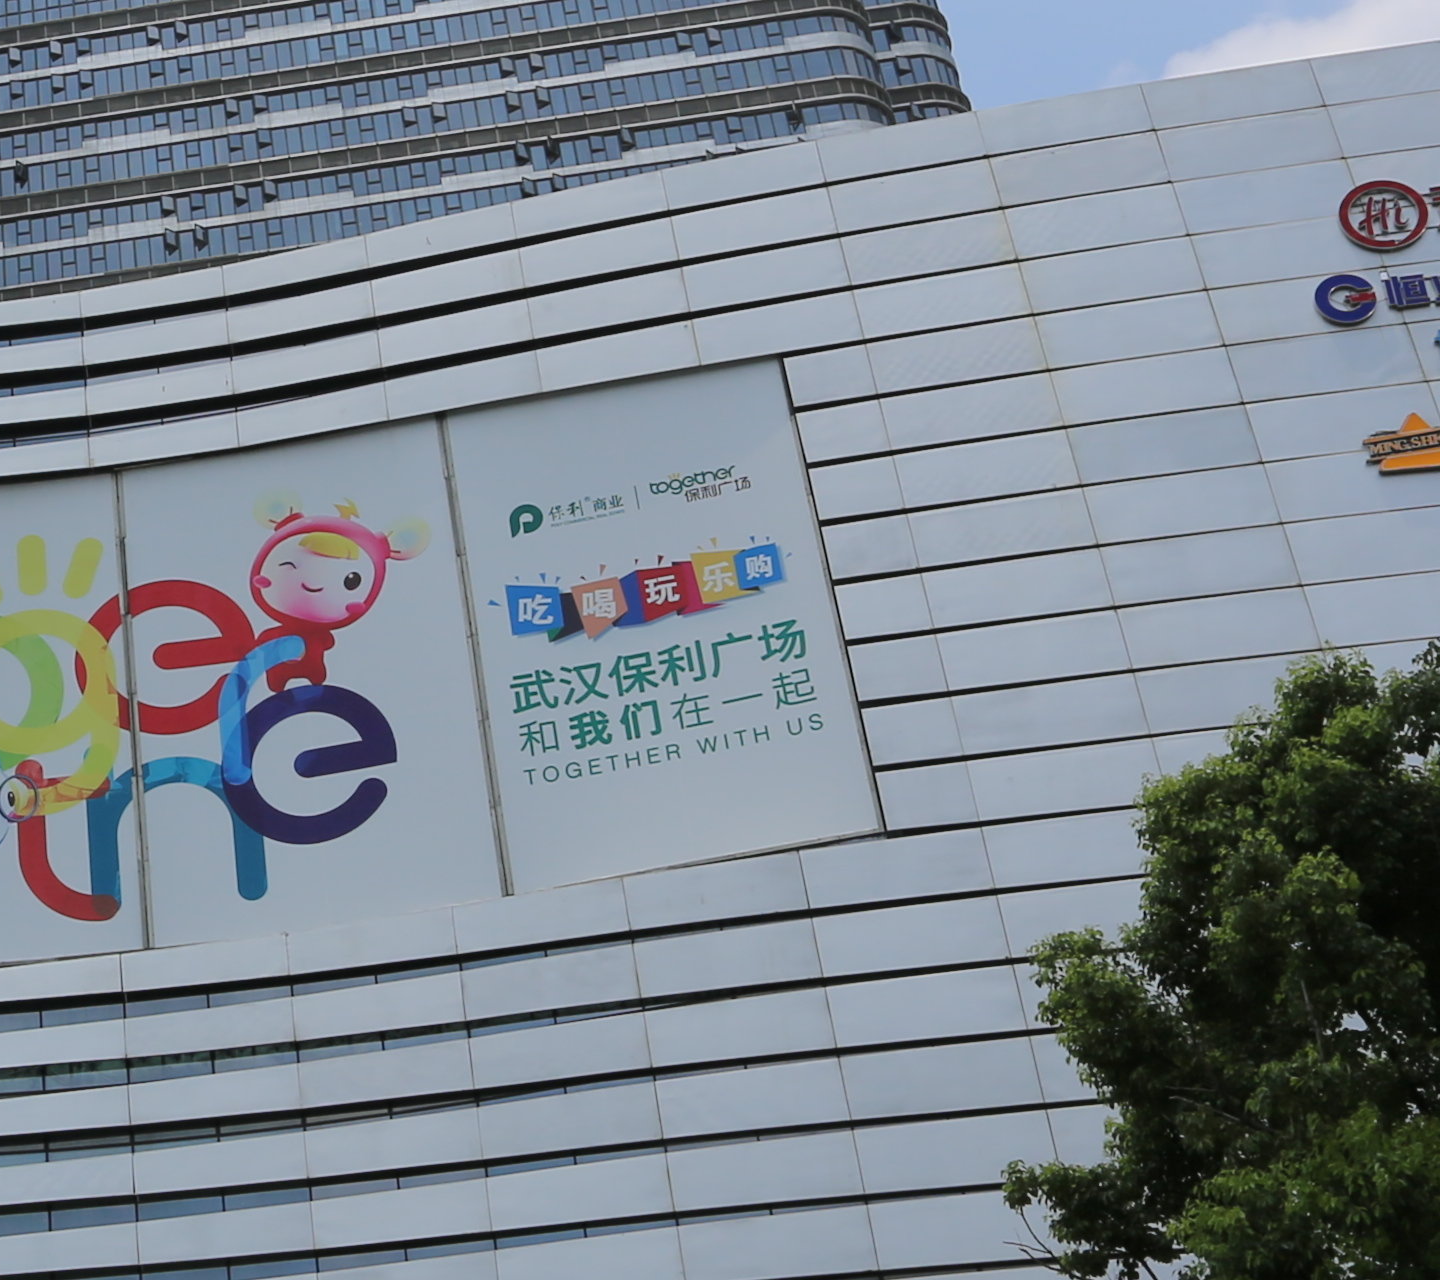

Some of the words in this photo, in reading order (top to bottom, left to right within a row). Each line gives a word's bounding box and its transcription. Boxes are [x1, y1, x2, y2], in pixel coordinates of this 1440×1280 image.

[684, 476, 752, 503] 保利广场
[517, 554, 774, 626] 吃喝玩乐购
[510, 619, 808, 714] 武汉保利广场
[519, 668, 818, 758] 和我们在一起
[523, 744, 682, 786] TOGETHER
[697, 725, 771, 754] WITH
[786, 713, 824, 736] US
